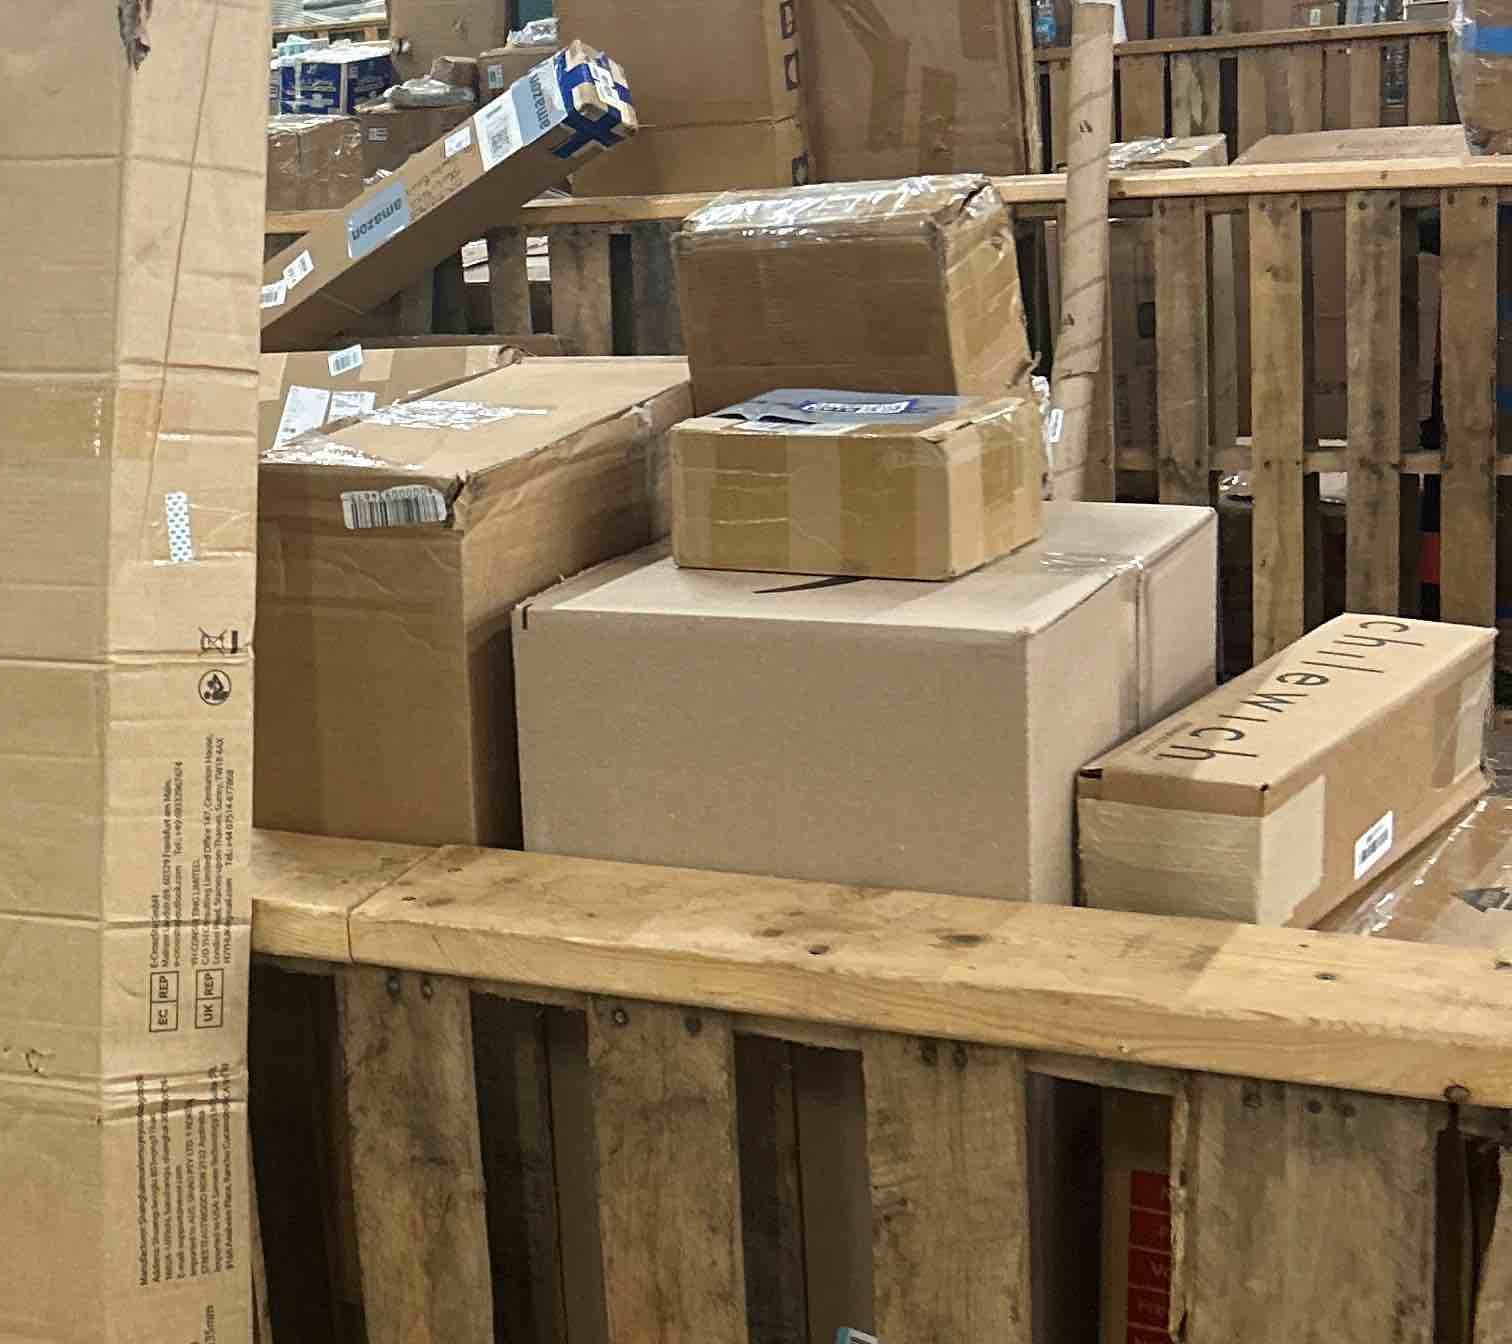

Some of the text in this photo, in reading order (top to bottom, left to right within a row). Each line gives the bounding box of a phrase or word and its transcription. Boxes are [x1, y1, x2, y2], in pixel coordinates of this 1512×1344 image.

[528, 72, 553, 131] amazon
[351, 197, 403, 241] amazon
[157, 975, 170, 1026] EC REP
[202, 972, 215, 1023] UK REP
